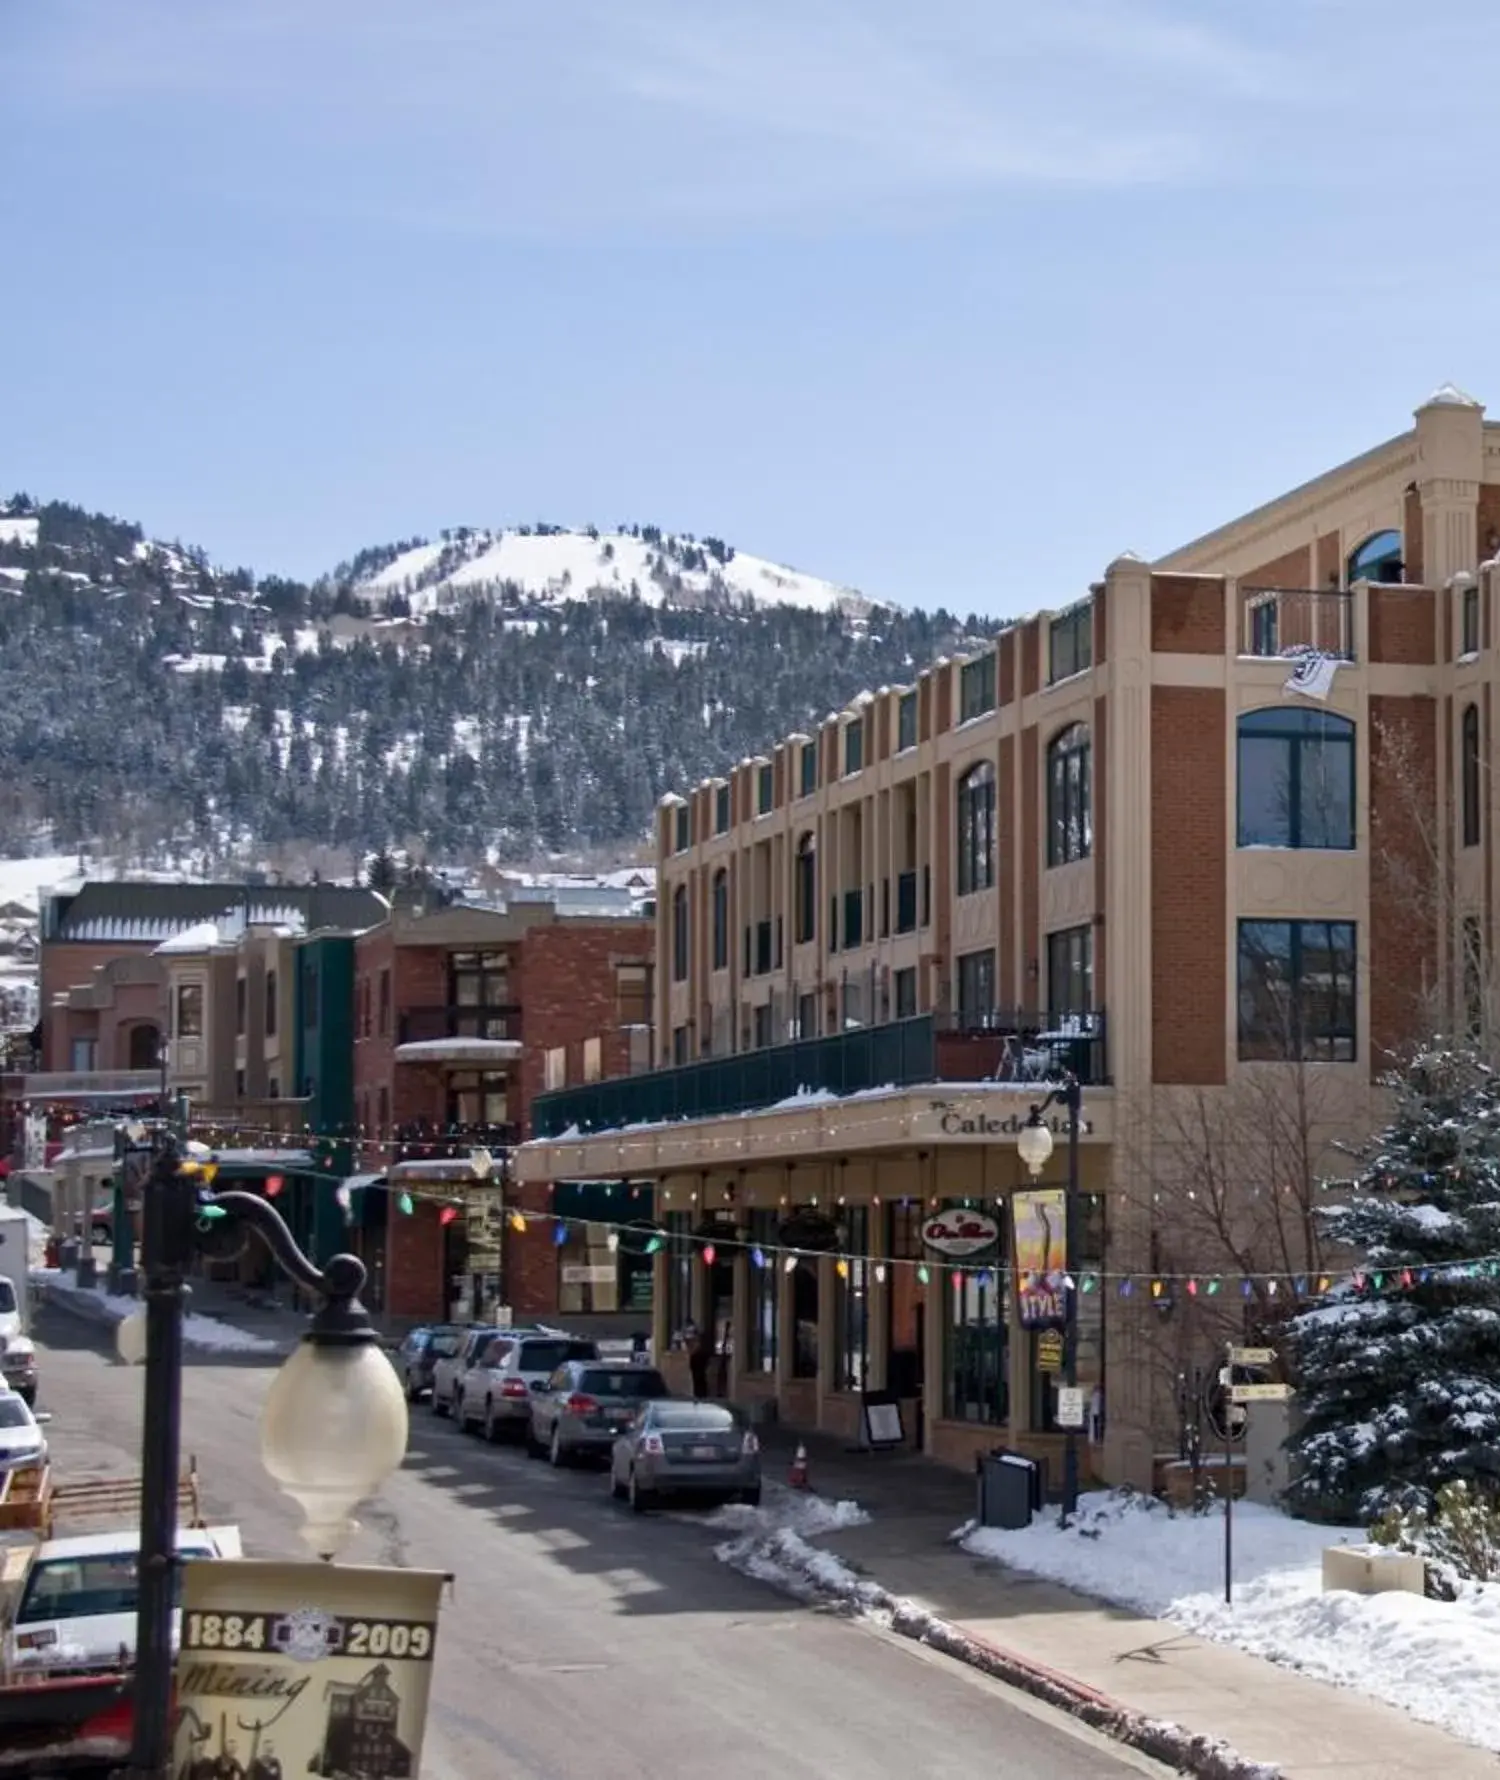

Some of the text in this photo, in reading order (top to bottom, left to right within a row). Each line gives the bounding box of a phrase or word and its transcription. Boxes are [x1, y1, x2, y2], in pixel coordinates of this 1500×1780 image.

[1021, 1292, 1064, 1320] STYLE
[188, 1614, 431, 1658] 1884 2009
[181, 1663, 311, 1726] Mining
